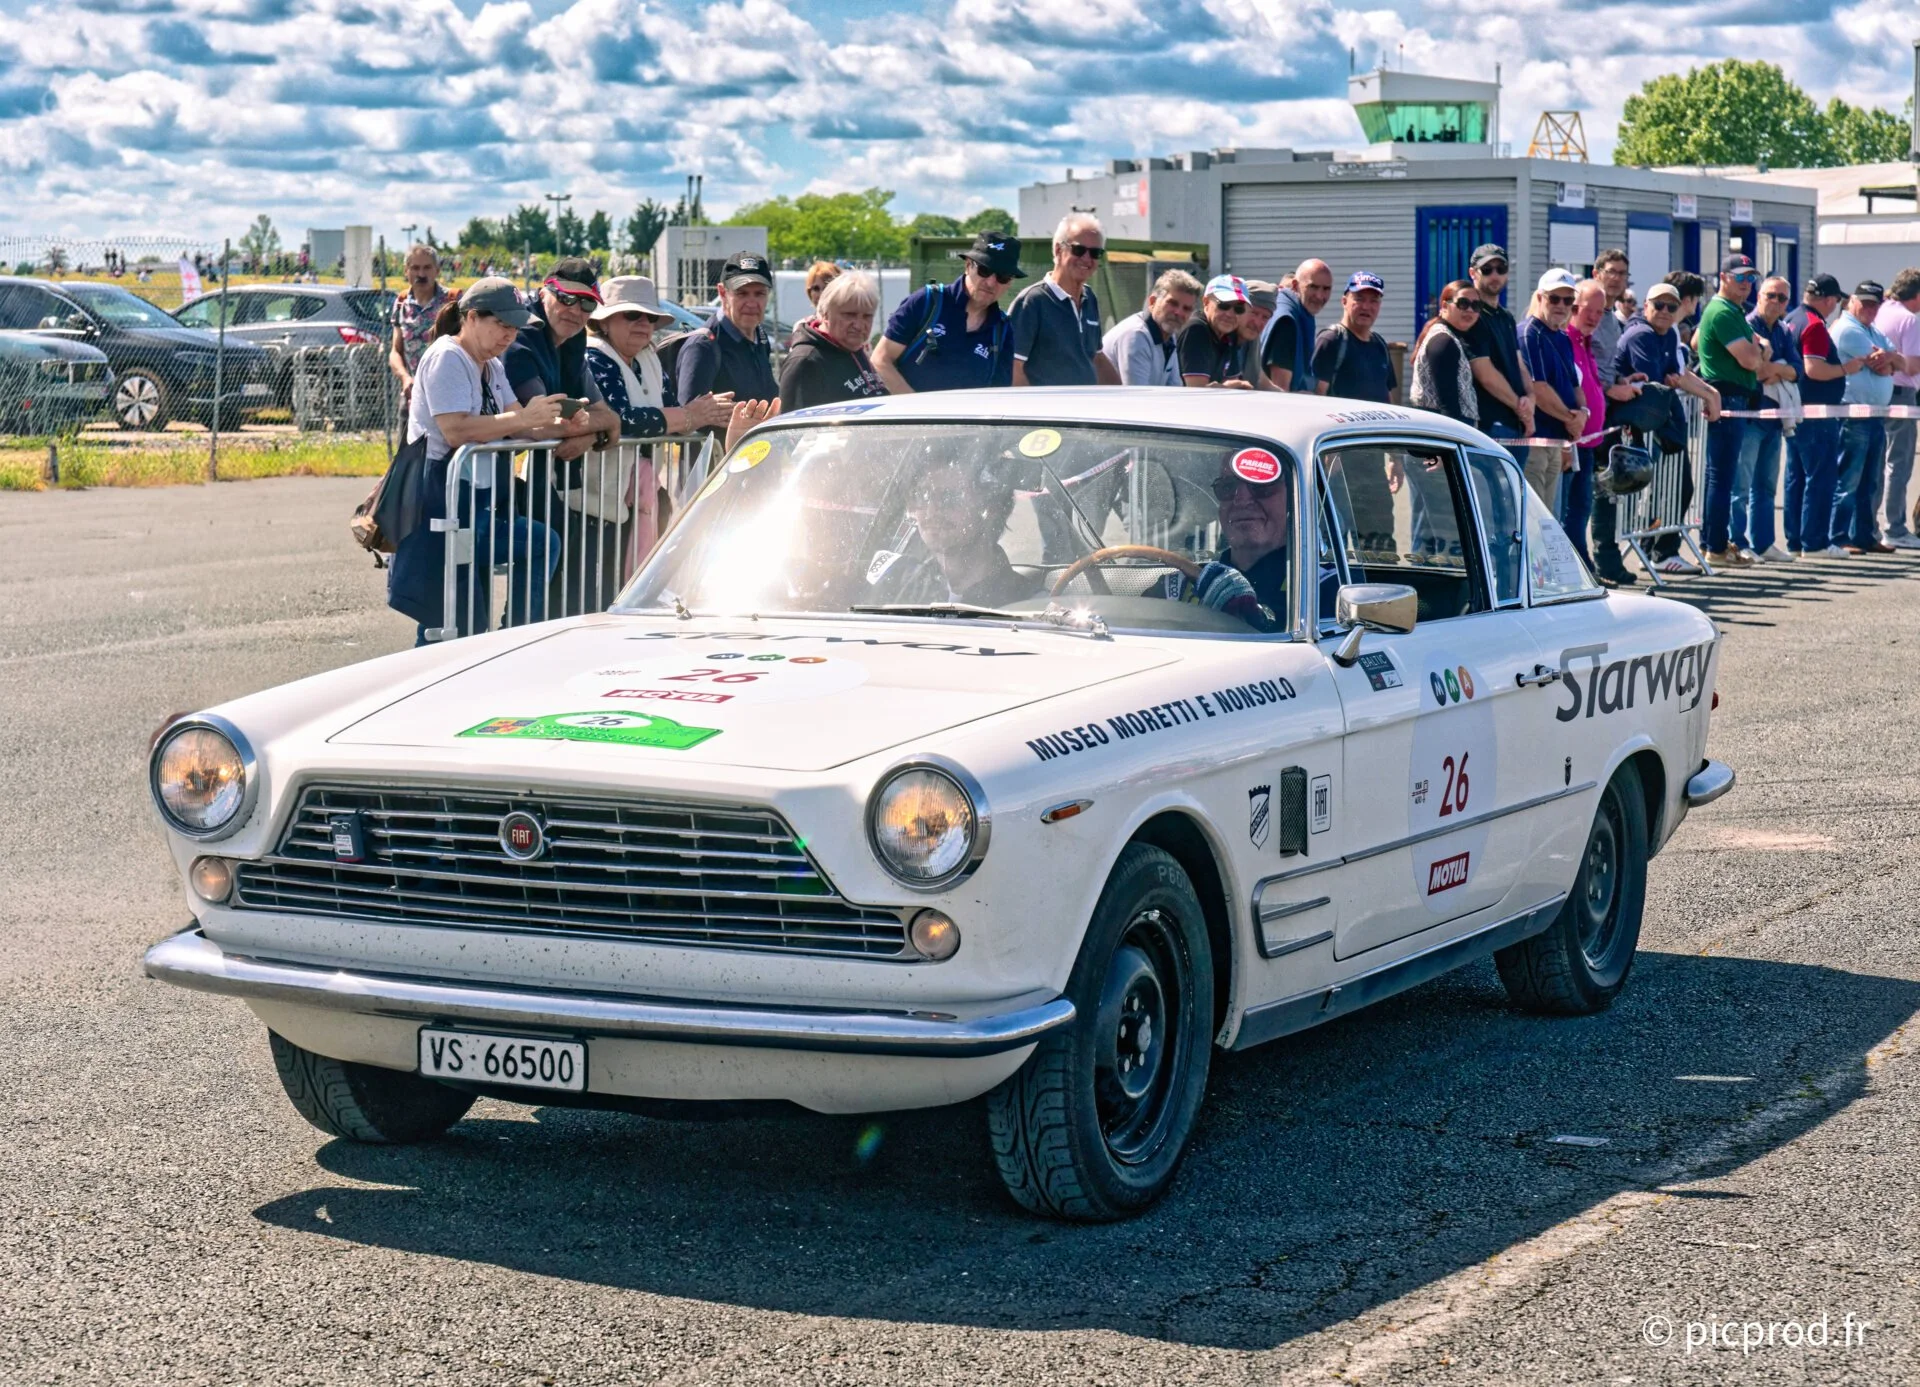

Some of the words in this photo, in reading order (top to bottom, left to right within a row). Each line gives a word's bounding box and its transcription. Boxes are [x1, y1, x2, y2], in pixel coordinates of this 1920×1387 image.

[1240, 459, 1274, 471] PARADE
[1360, 654, 1388, 668] BALTIC
[659, 669, 769, 683] 26
[608, 690, 723, 702] MOTUL
[575, 715, 629, 726] 26
[1025, 723, 1110, 761] MUSEO
[1106, 699, 1199, 740] MORETTI
[1195, 695, 1216, 718] E
[1212, 677, 1297, 713] NONSOLO
[1439, 752, 1469, 817] 26
[1315, 788, 1327, 816] FIAT
[512, 829, 530, 844] FIAT
[1431, 858, 1467, 890] MOTUL
[430, 1036, 463, 1072] VS
[484, 1042, 575, 1083] 66500
